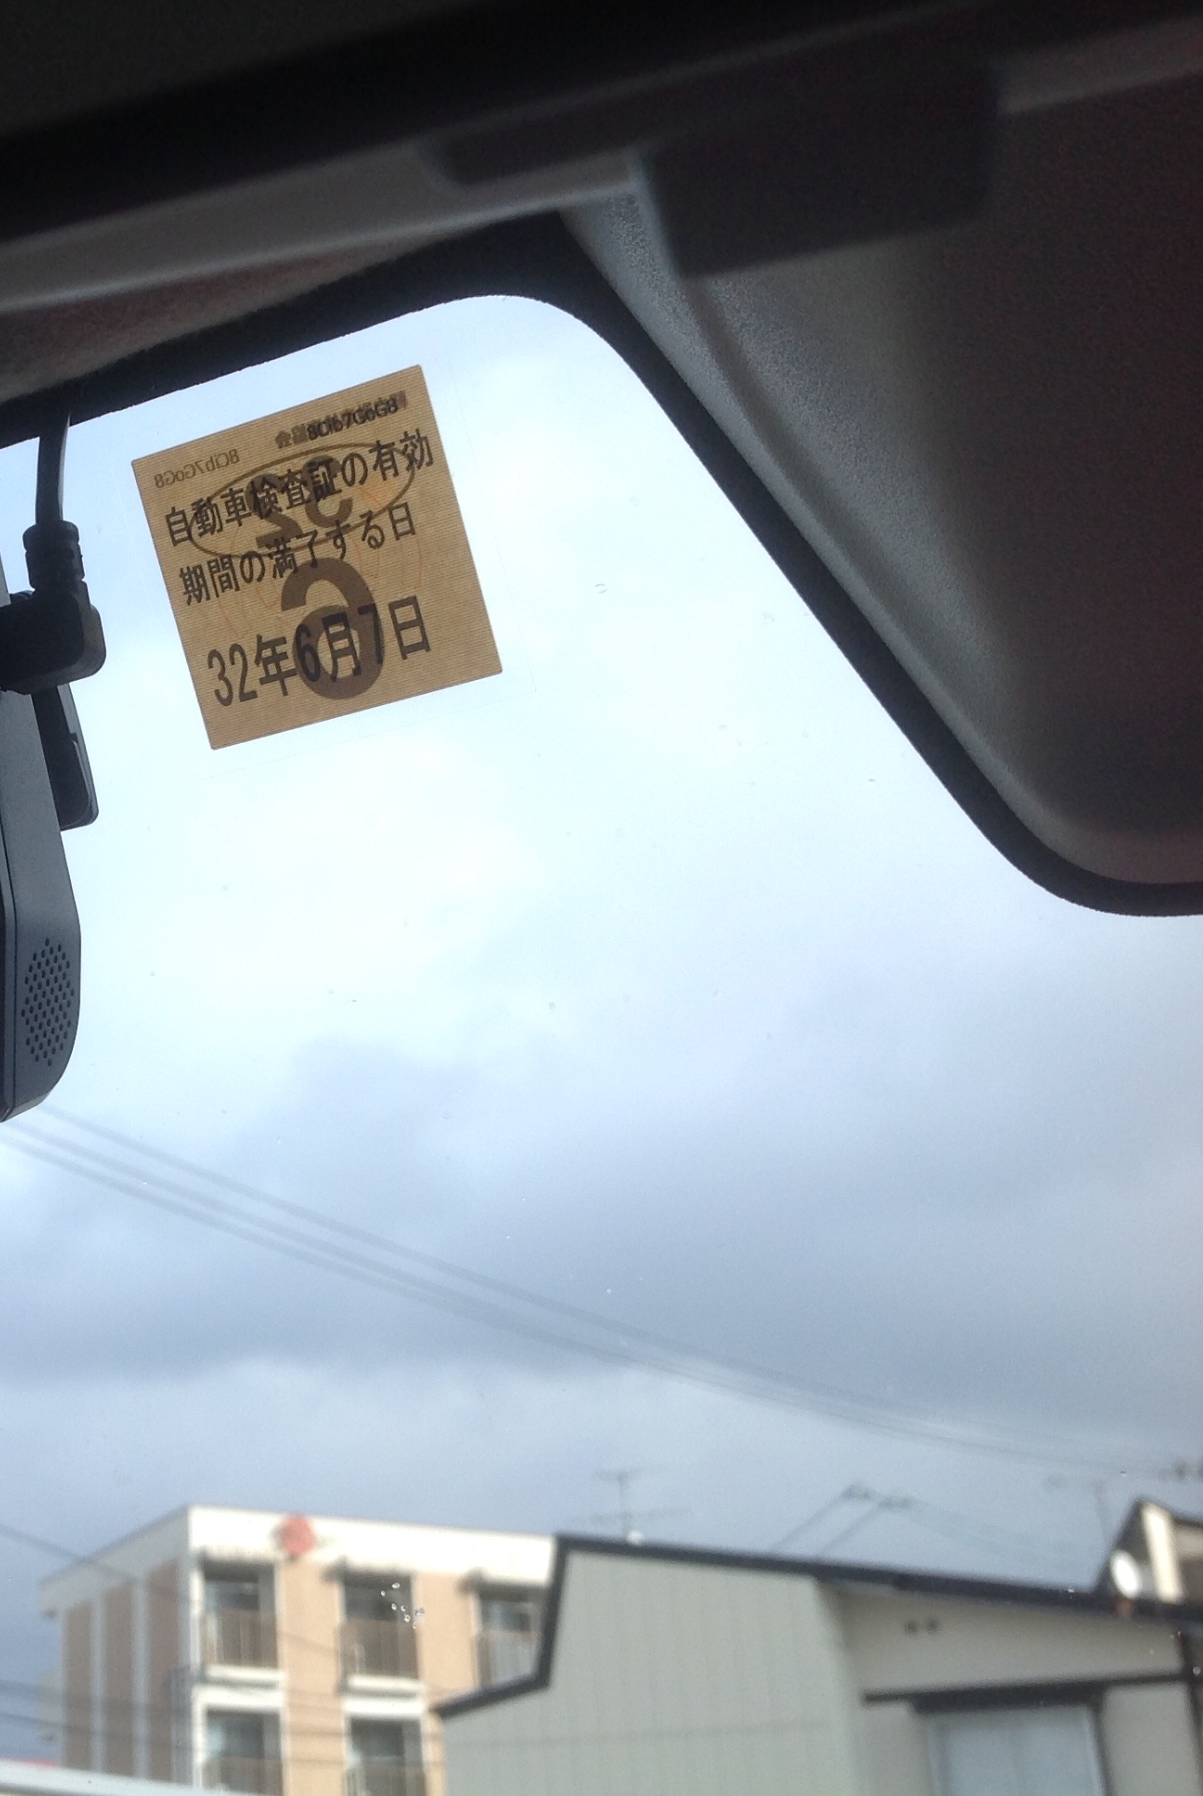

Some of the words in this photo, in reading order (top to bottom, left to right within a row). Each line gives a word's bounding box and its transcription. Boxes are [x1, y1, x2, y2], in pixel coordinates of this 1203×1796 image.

[165, 429, 434, 548] 自動車検査証の有効
[180, 502, 416, 606] 期間の満了する日
[207, 595, 432, 708] 32年6月7日
